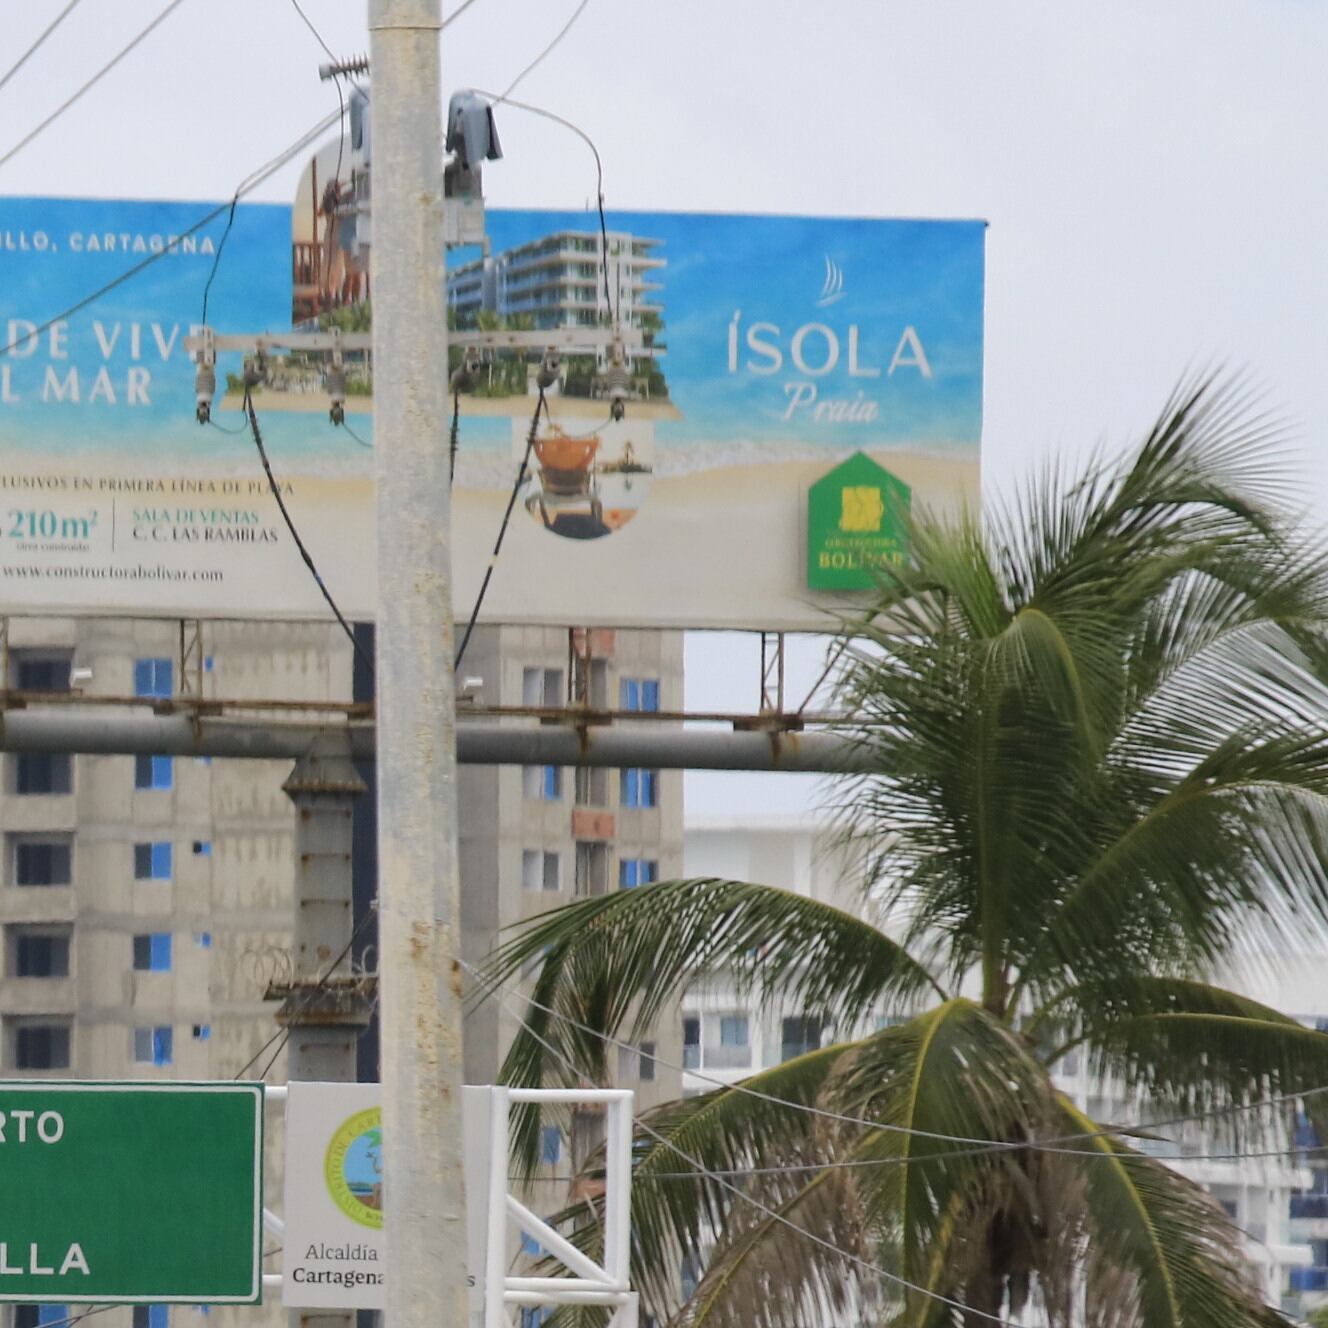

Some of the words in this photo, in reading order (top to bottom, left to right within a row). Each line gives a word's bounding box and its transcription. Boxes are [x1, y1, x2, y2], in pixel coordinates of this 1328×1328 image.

[69, 232, 215, 255] CARTAGENA
[727, 309, 933, 379] ÍSOLA
[42, 364, 152, 406] MAR
[777, 380, 880, 423] Praia
[74, 477, 93, 490] EN
[99, 477, 165, 493] PRIMERA
[222, 480, 241, 494] DE
[132, 509, 171, 523] SALA
[199, 510, 260, 525] VENTAS
[172, 527, 200, 542] LAS
[204, 528, 279, 543] RAMBLAS
[3, 563, 224, 583] www.constructorabolivar.com
[304, 1243, 380, 1262] Alcaldía
